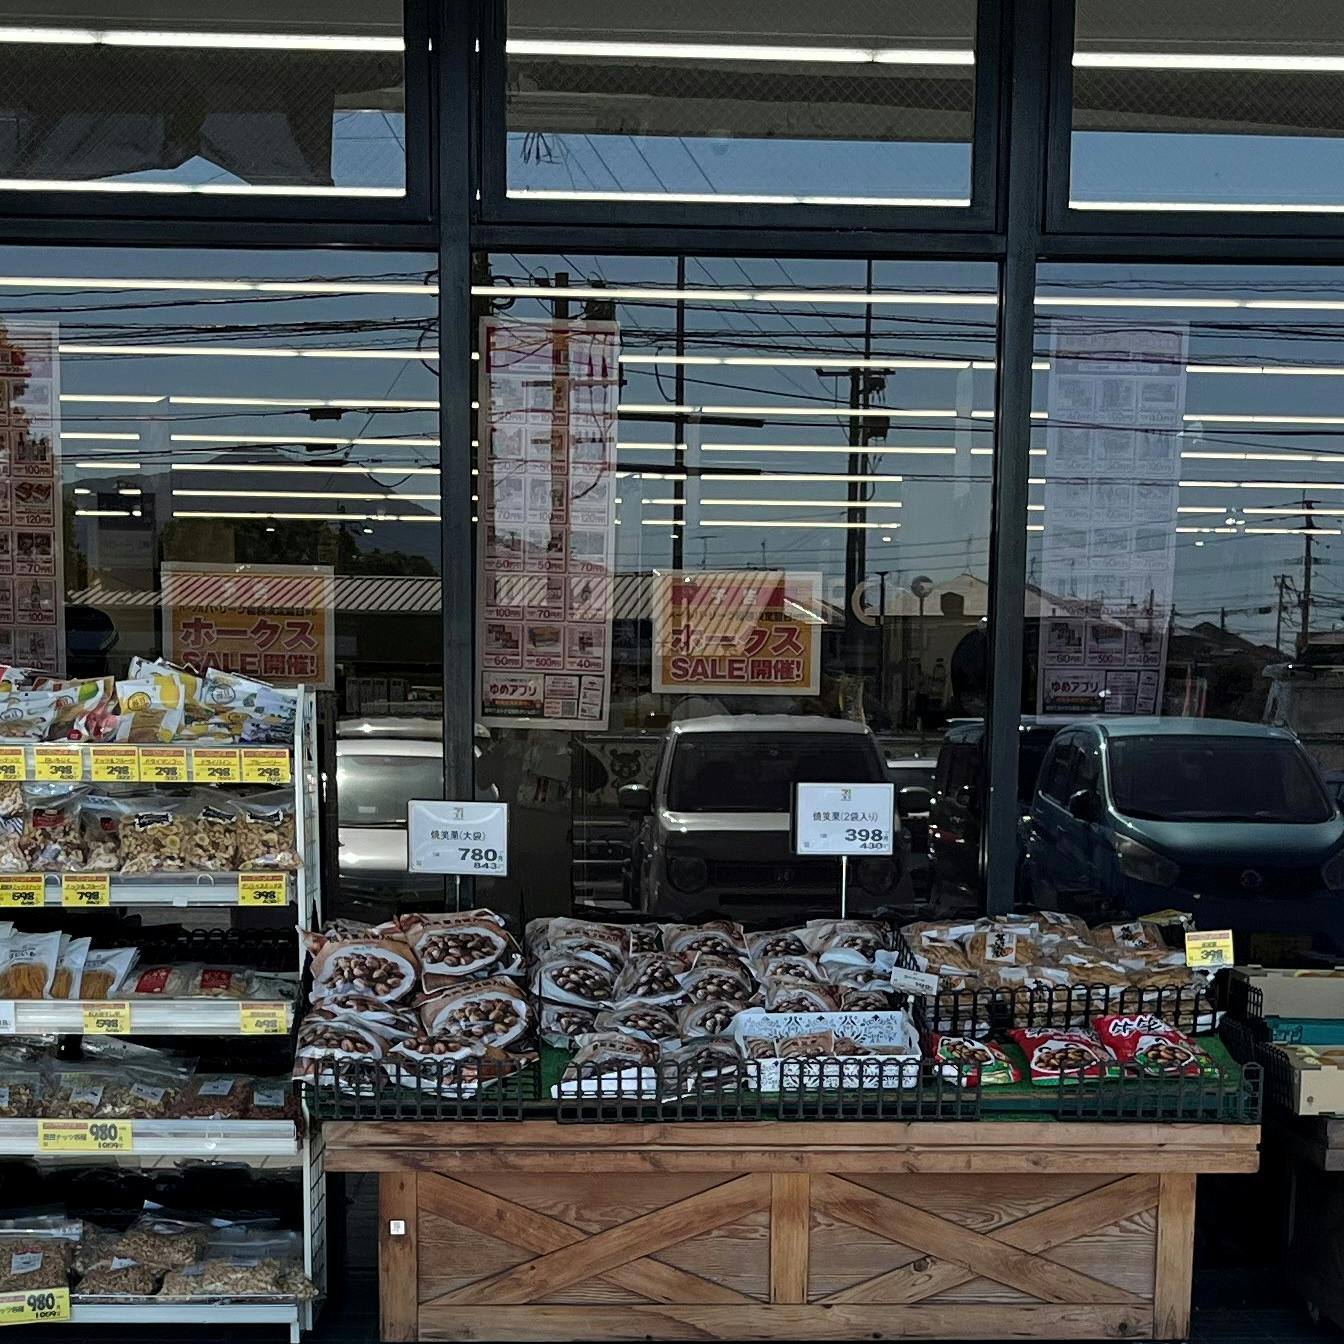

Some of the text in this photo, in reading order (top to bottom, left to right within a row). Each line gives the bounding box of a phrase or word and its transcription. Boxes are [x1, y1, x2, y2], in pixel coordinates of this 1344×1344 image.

[180, 616, 318, 651] ホークス
[671, 624, 804, 656] ホークス
[671, 657, 747, 681] SALE
[490, 683, 537, 697] ゆめアプリ
[1051, 681, 1099, 693] ゆめアプリ
[845, 828, 883, 842] 398
[860, 842, 883, 850] 430
[458, 848, 498, 862] 780
[473, 862, 498, 870] 843
[89, 1123, 118, 1142] 980
[27, 1292, 56, 1312] 980
